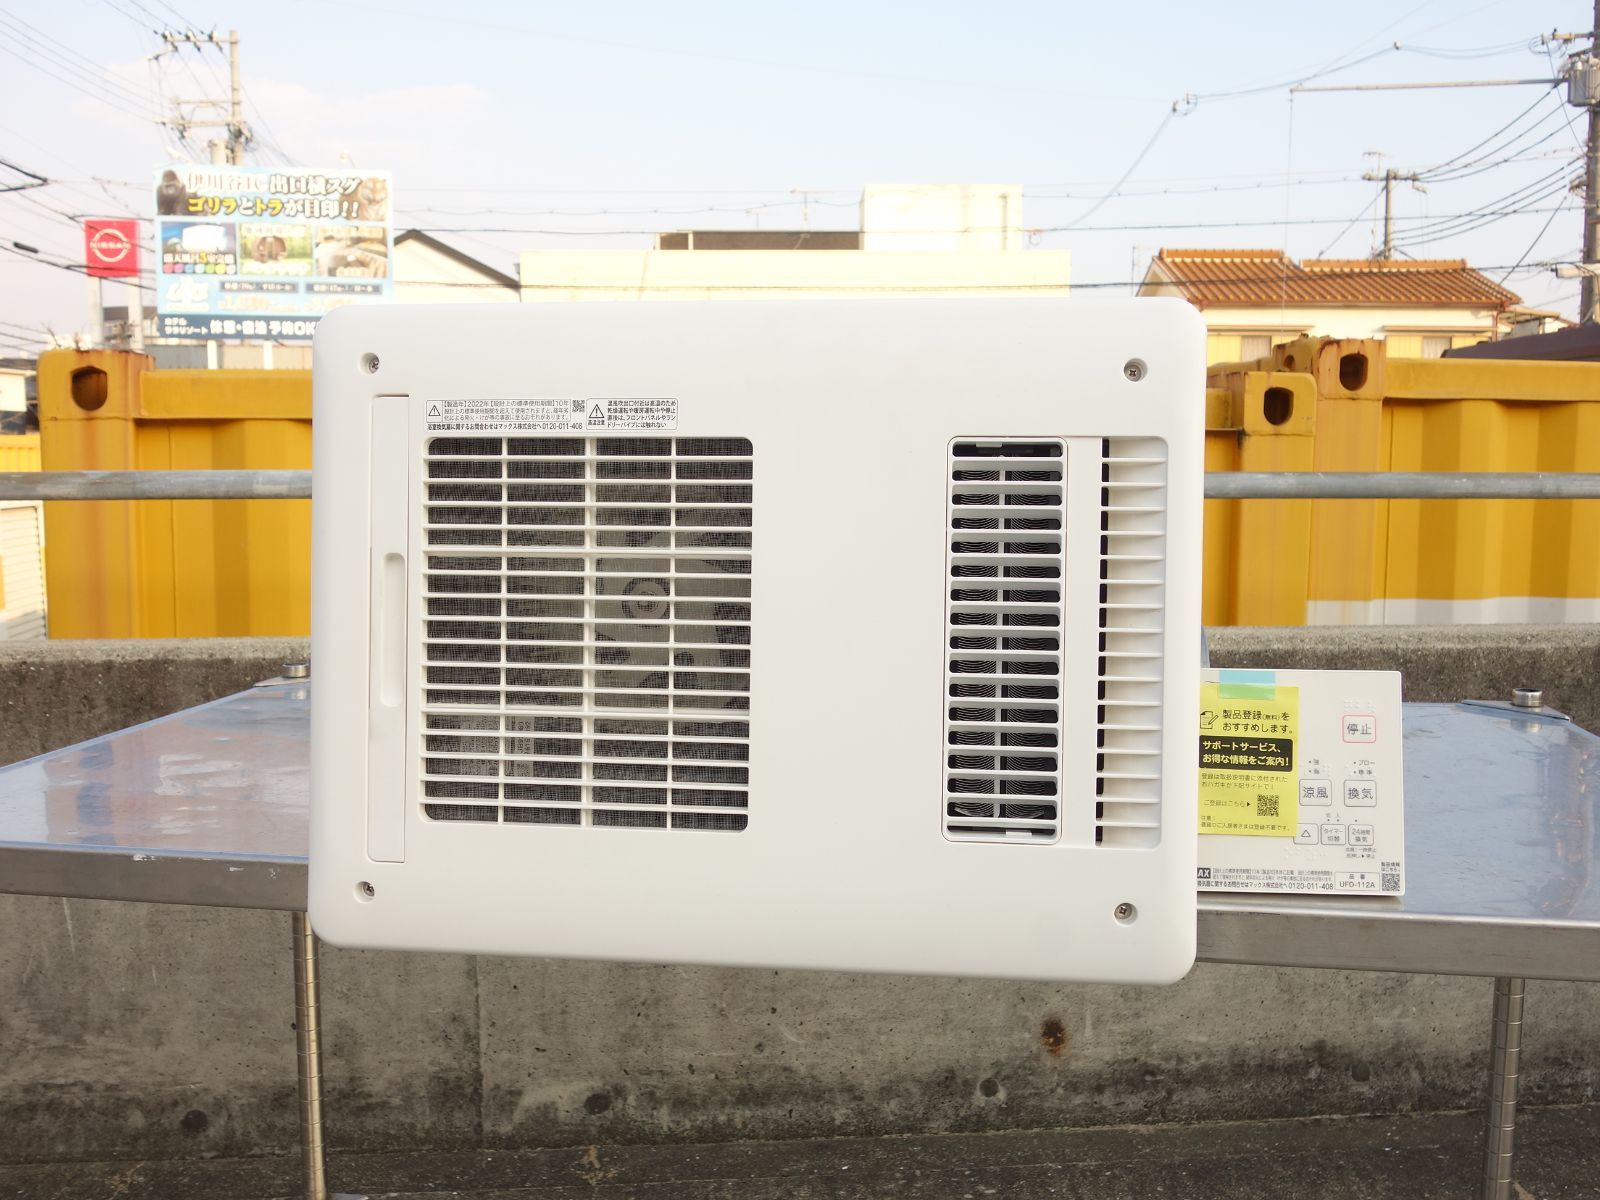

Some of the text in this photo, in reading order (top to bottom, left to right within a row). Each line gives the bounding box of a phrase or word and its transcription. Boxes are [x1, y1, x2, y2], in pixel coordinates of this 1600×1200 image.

[1222, 722, 1293, 734] おすすめします。
[1346, 722, 1372, 736] 停止
[1202, 740, 1281, 753] サポートサービス、
[1303, 786, 1329, 799] 涼風
[1347, 787, 1374, 800] 換気
[1339, 881, 1376, 889] UFD-112A
